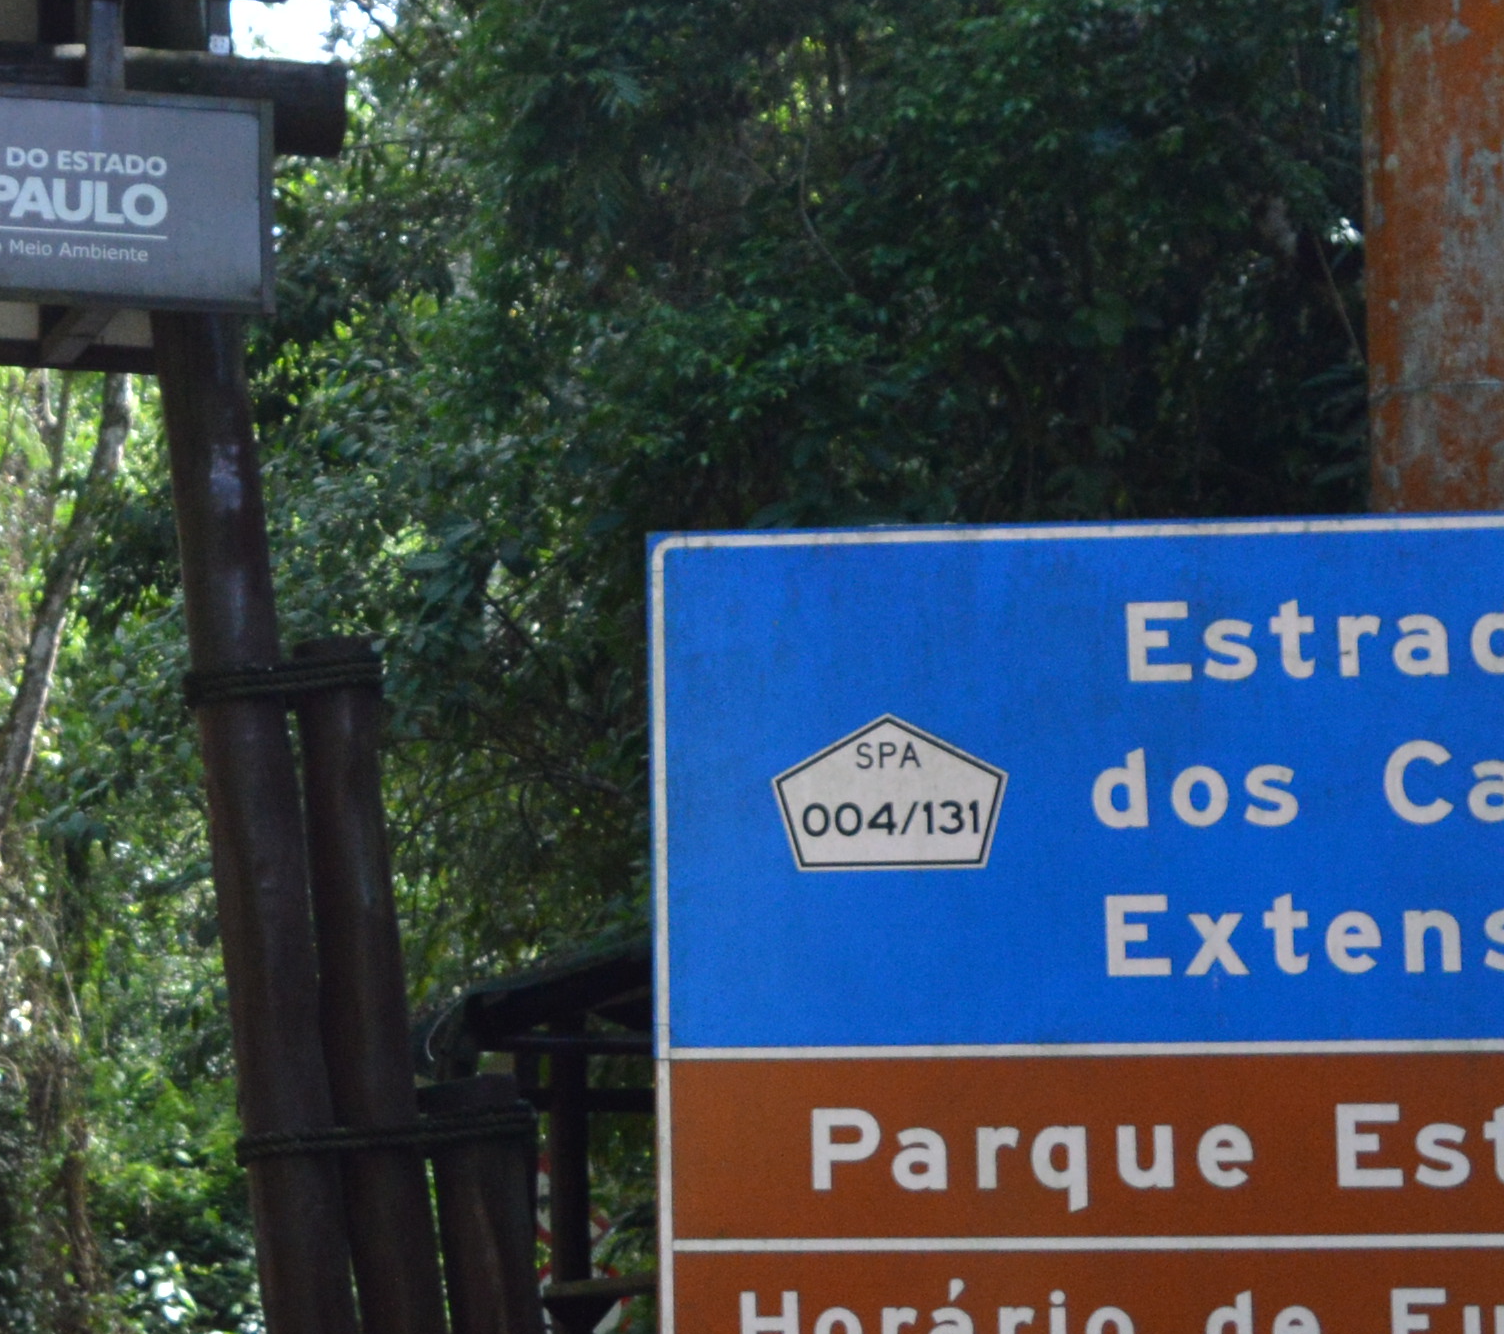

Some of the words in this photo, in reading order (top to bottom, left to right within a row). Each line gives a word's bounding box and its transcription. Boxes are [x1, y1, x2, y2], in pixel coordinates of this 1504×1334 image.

[5, 146, 50, 170] DO
[56, 149, 168, 178] ESTADO
[8, 238, 53, 257] Meio
[58, 241, 149, 263] Ambiente
[855, 741, 922, 770] SPA
[1091, 747, 1299, 829] dos
[801, 799, 980, 838] 004/131
[811, 1107, 1253, 1212] Parque
